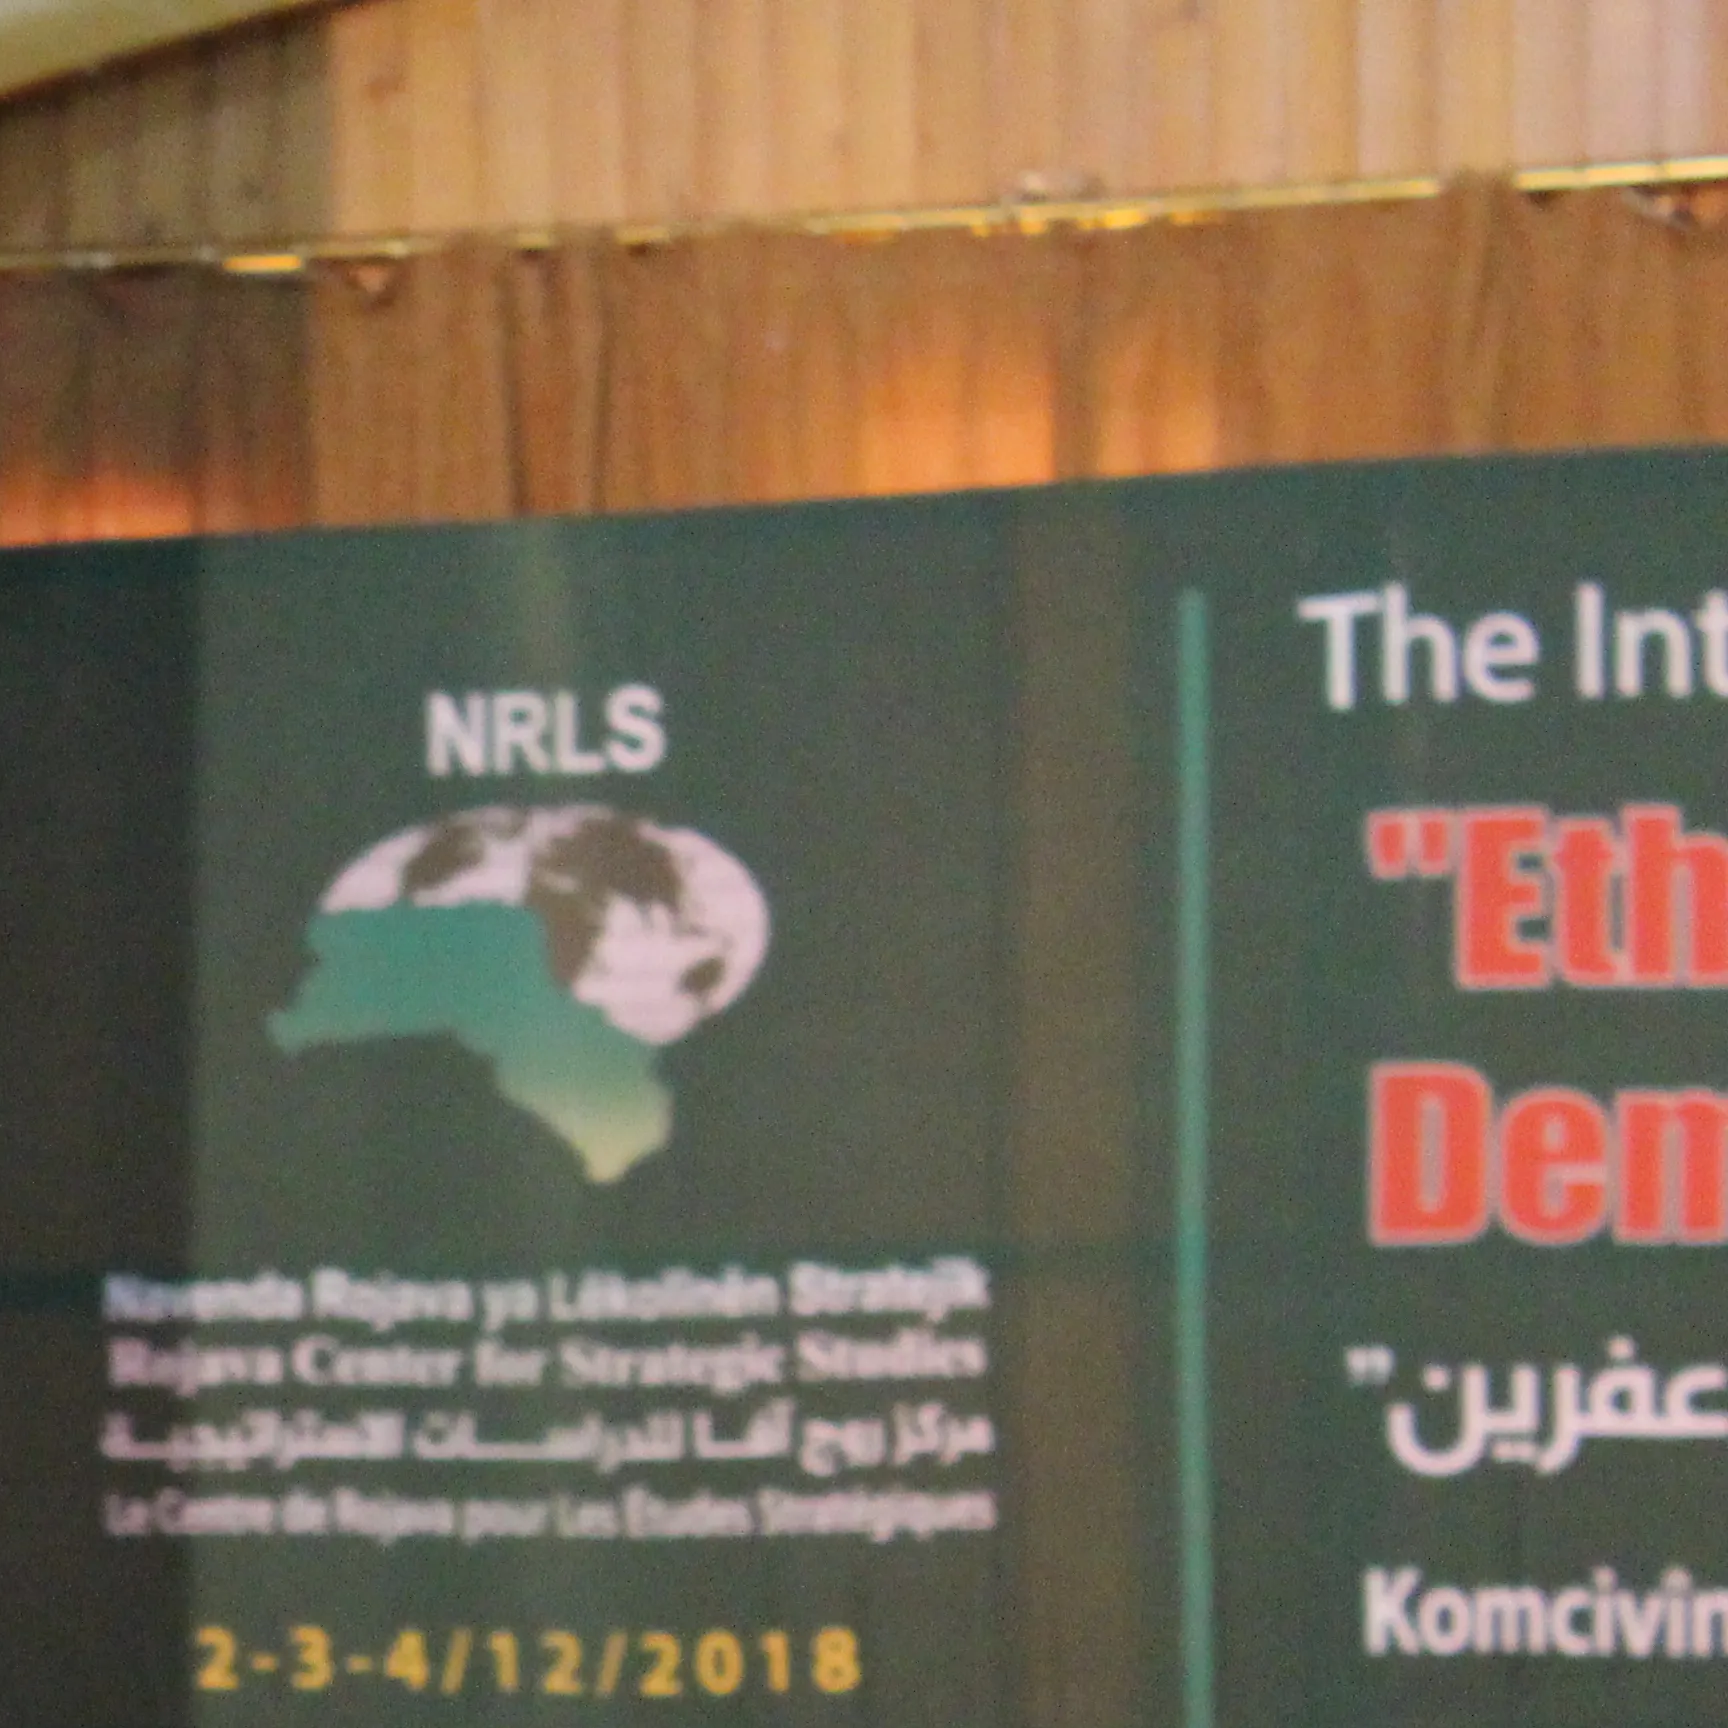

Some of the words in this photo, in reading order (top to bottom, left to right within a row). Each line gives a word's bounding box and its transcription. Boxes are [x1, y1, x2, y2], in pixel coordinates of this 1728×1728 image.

[1298, 580, 1540, 711] The
[1575, 581, 1728, 700] Int
[424, 683, 667, 777] NRLS
[311, 1266, 474, 1331] Rojava
[479, 1280, 539, 1334] ya
[107, 1335, 284, 1397] Rojava
[289, 1333, 463, 1386] Center
[473, 1335, 548, 1386] for
[557, 1333, 787, 1394] Strategic
[795, 1328, 988, 1382] Studies
[799, 1417, 886, 1478] روج
[892, 1400, 996, 1466] مركز
[105, 1493, 148, 1536] Le
[150, 1486, 275, 1536] Centre
[280, 1485, 328, 1535] de
[331, 1486, 453, 1546] Rojava
[458, 1496, 544, 1545] pour
[196, 1623, 862, 1697] 2-3-4/12/2018
